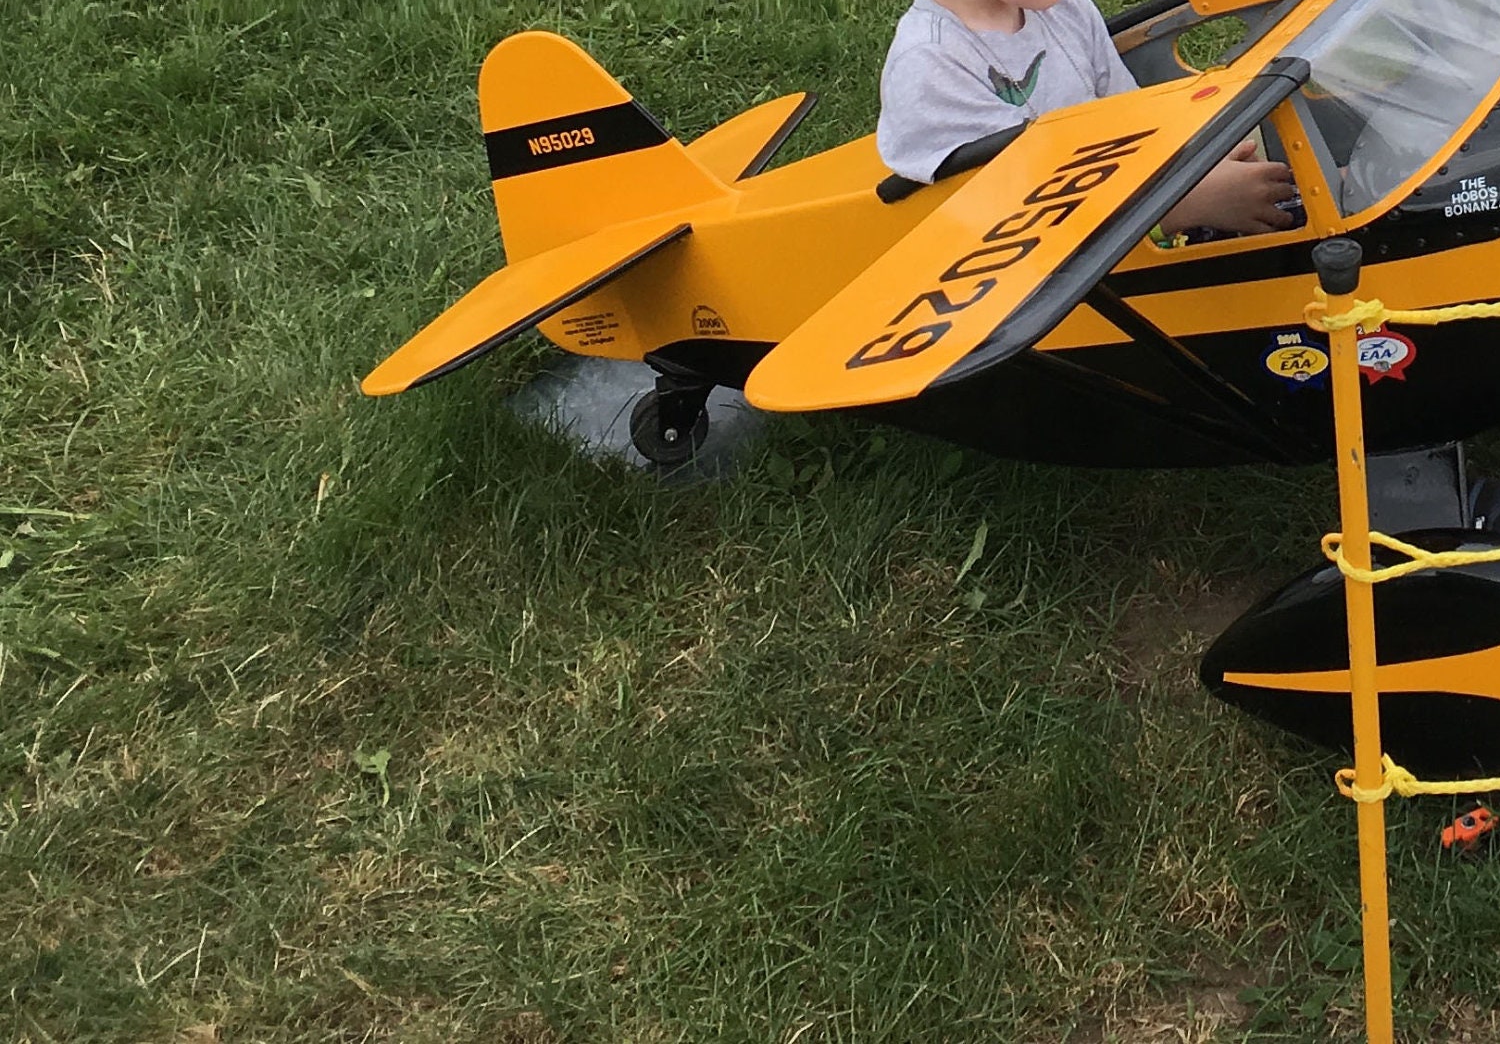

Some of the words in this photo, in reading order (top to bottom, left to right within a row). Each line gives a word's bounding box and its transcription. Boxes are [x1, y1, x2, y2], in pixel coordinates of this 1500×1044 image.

[527, 127, 595, 156] N95029
[1459, 176, 1487, 191] THE
[1451, 186, 1499, 205] HOBO'S
[844, 127, 1160, 371] N95029
[1360, 348, 1393, 362] EAA
[1280, 359, 1311, 371] EAA
